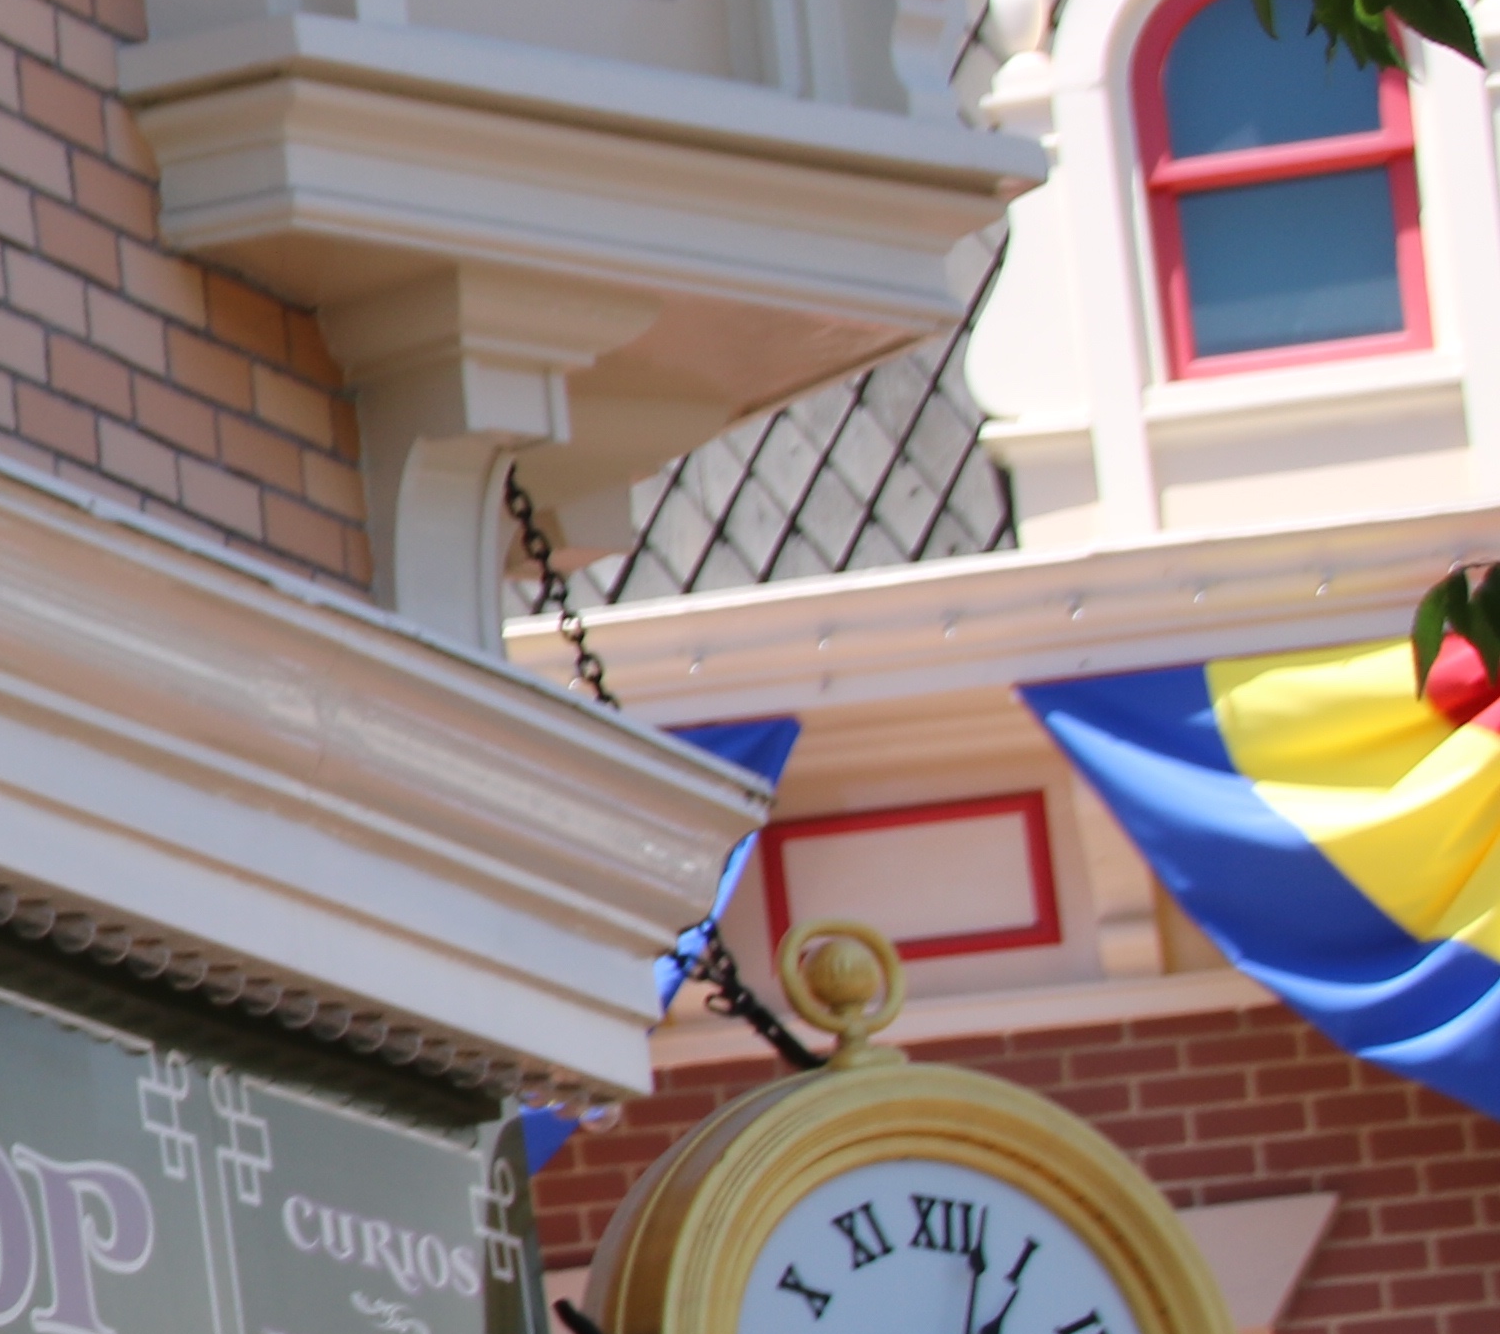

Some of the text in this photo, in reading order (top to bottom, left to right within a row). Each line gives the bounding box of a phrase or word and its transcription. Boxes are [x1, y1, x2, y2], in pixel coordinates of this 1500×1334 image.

[281, 1194, 484, 1297] CURIOS
[831, 1201, 895, 1271] XI
[910, 1194, 974, 1255] XII
[1006, 1236, 1040, 1285] I
[776, 1263, 833, 1320] X
